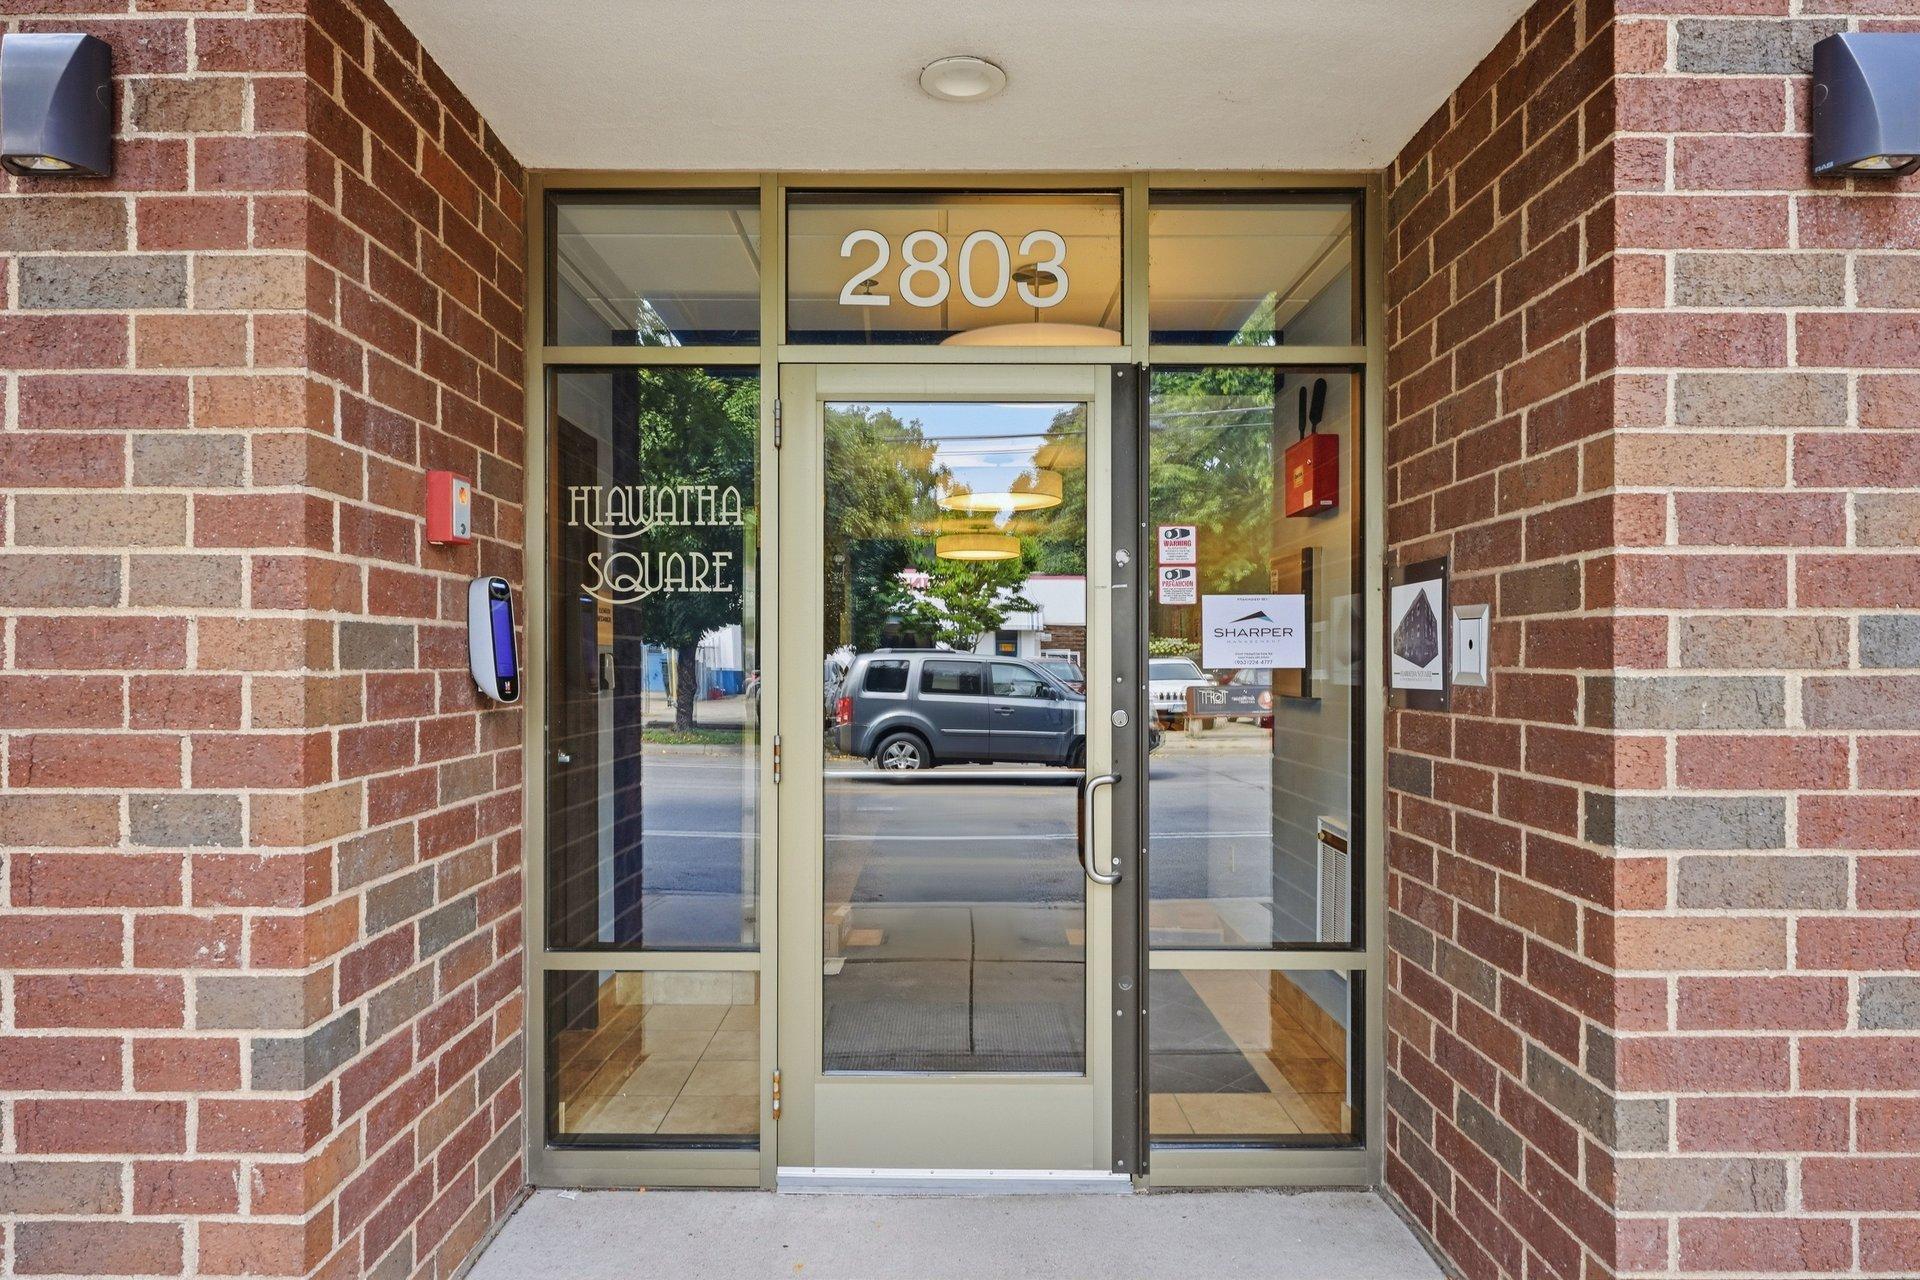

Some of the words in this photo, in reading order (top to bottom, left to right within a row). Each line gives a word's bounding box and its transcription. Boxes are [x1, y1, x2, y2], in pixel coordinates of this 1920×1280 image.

[839, 229, 1070, 308] 2803
[567, 485, 745, 539] HIAWATHA
[581, 551, 733, 605] SQUARE
[1214, 627, 1294, 638] SHARPER
